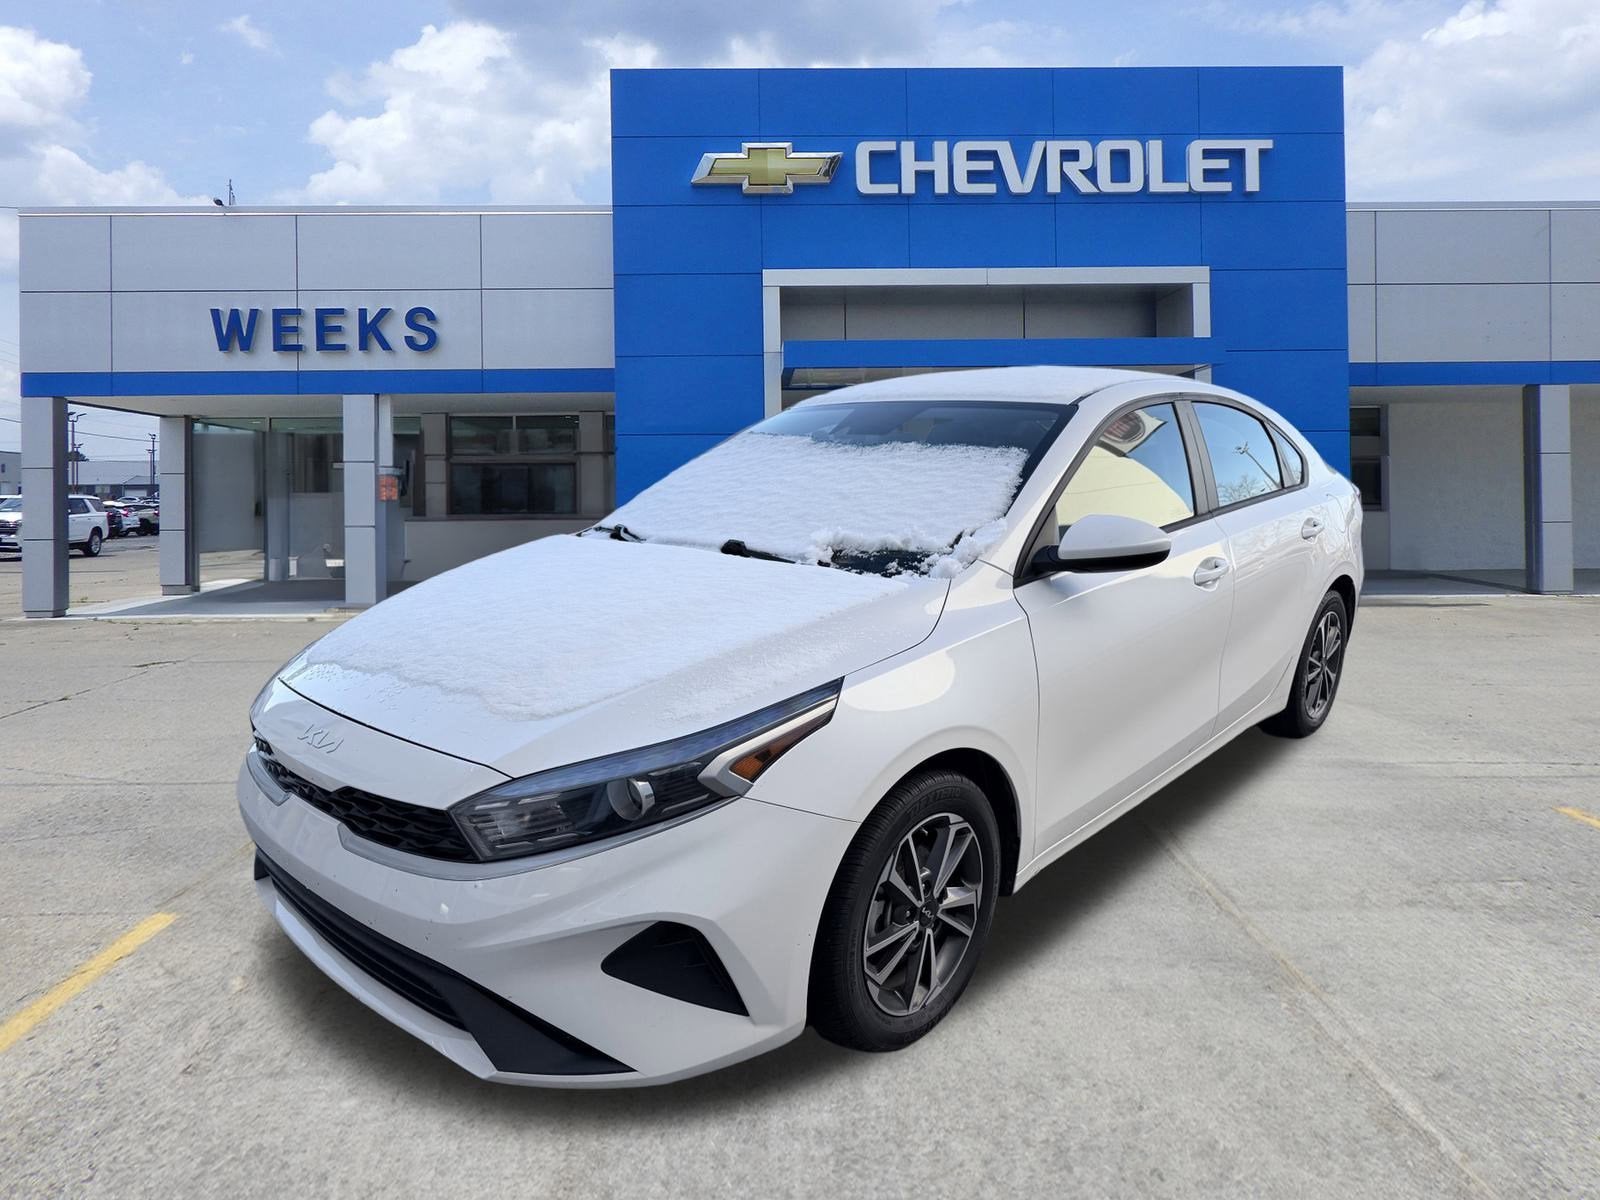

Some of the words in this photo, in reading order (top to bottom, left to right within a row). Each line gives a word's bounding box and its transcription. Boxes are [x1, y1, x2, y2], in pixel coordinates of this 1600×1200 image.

[855, 139, 1275, 194] CHEVROLET
[210, 306, 438, 352] WEEKS
[297, 724, 345, 754] KIA
